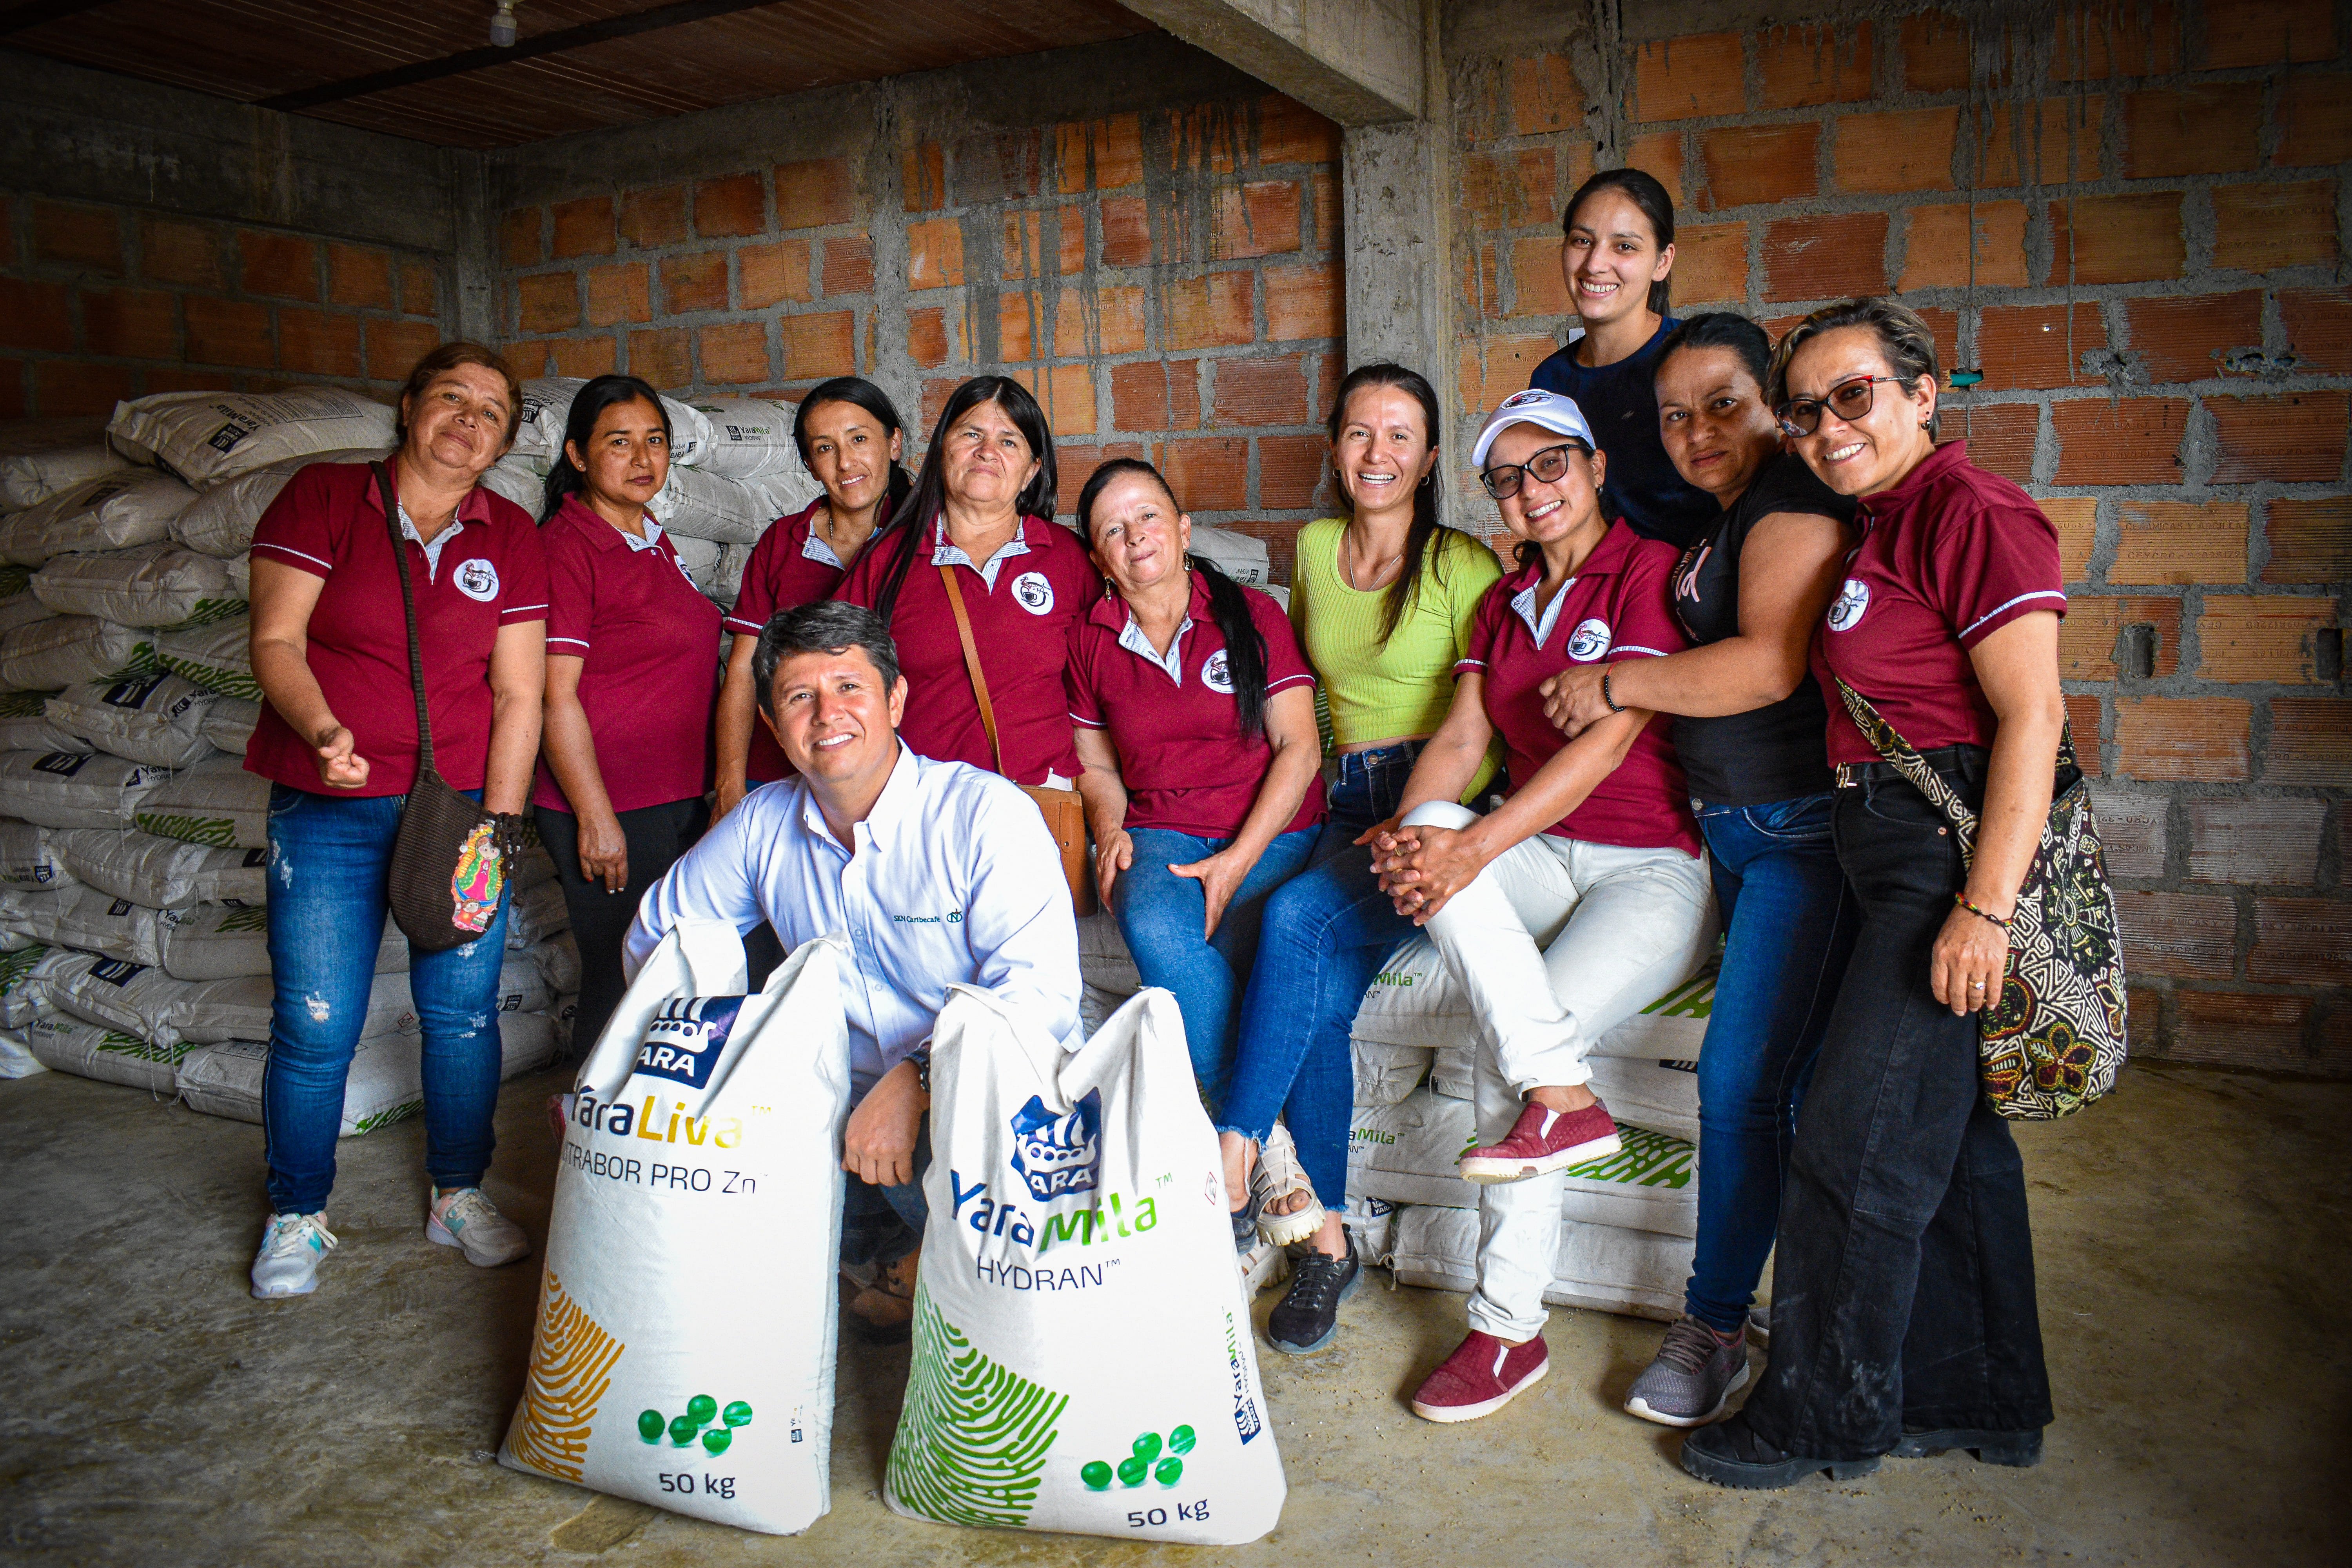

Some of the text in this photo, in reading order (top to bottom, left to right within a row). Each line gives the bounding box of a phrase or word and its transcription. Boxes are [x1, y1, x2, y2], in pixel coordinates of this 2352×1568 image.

[2250, 418, 2310, 426] CERAMICAS
[2252, 448, 2302, 456] CEYCRO
[2151, 916, 2209, 927] CERAMICAS
[2152, 944, 2200, 953] CEYCRO
[637, 1046, 695, 1077] ARA
[651, 1163, 711, 1192] PRO
[722, 1171, 756, 1194] Zn
[1027, 1168, 1093, 1194] ARA
[659, 1472, 736, 1499] 50 kg
[1127, 1499, 1210, 1527] 50 kg
